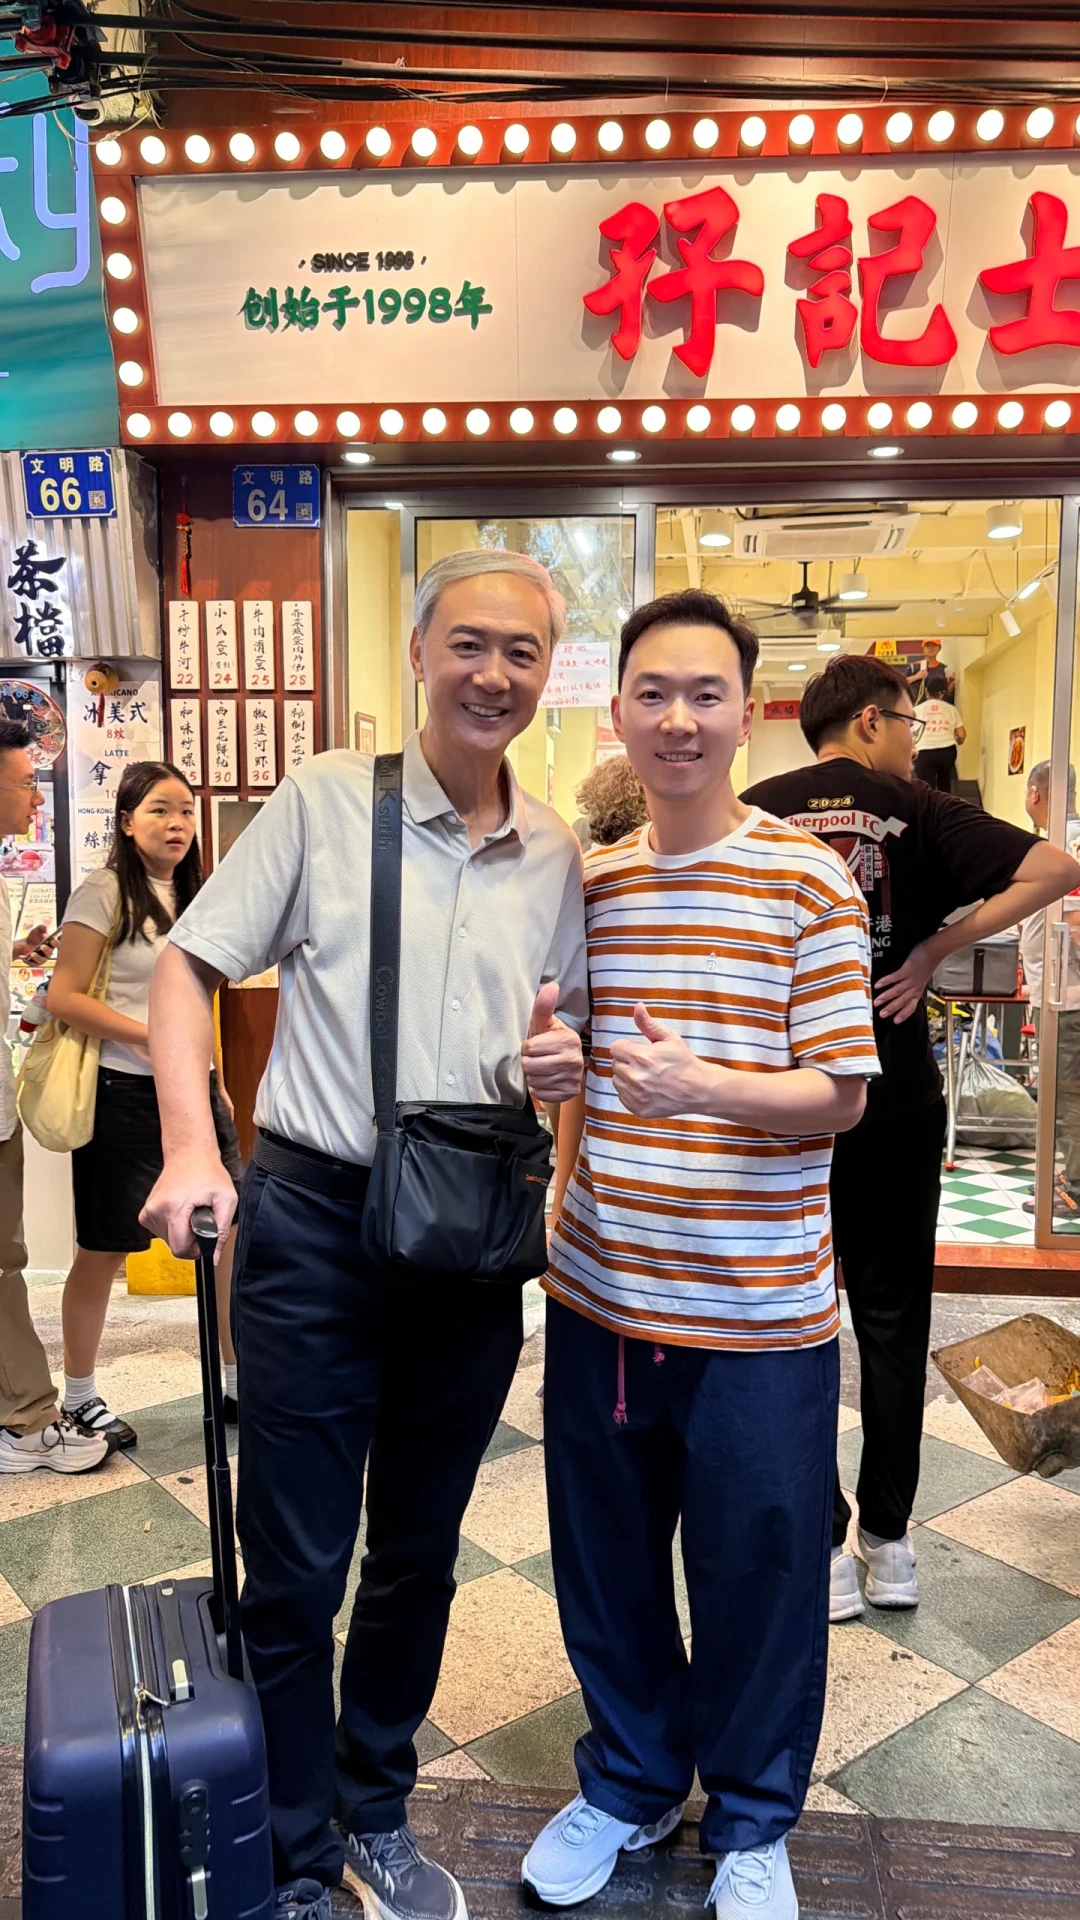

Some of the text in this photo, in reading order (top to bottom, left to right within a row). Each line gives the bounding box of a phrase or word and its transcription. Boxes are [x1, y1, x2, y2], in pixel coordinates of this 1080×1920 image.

[311, 251, 370, 273] SINCE
[241, 280, 493, 329] 创始于1998年
[30, 455, 104, 475] 文明路
[241, 469, 313, 485] 文明路
[40, 477, 82, 512] 66
[247, 489, 288, 521] 64
[8, 539, 66, 657] 茶檔
[177, 609, 192, 670] 干炒牛河
[176, 673, 193, 685] 22
[214, 673, 232, 684] 24
[251, 675, 270, 686] 25
[289, 675, 306, 686] 28
[84, 701, 148, 724] 冰美式
[214, 771, 231, 782] 30
[252, 770, 269, 781] 36
[808, 795, 854, 809] 2024
[788, 811, 880, 836] iverpool FC
